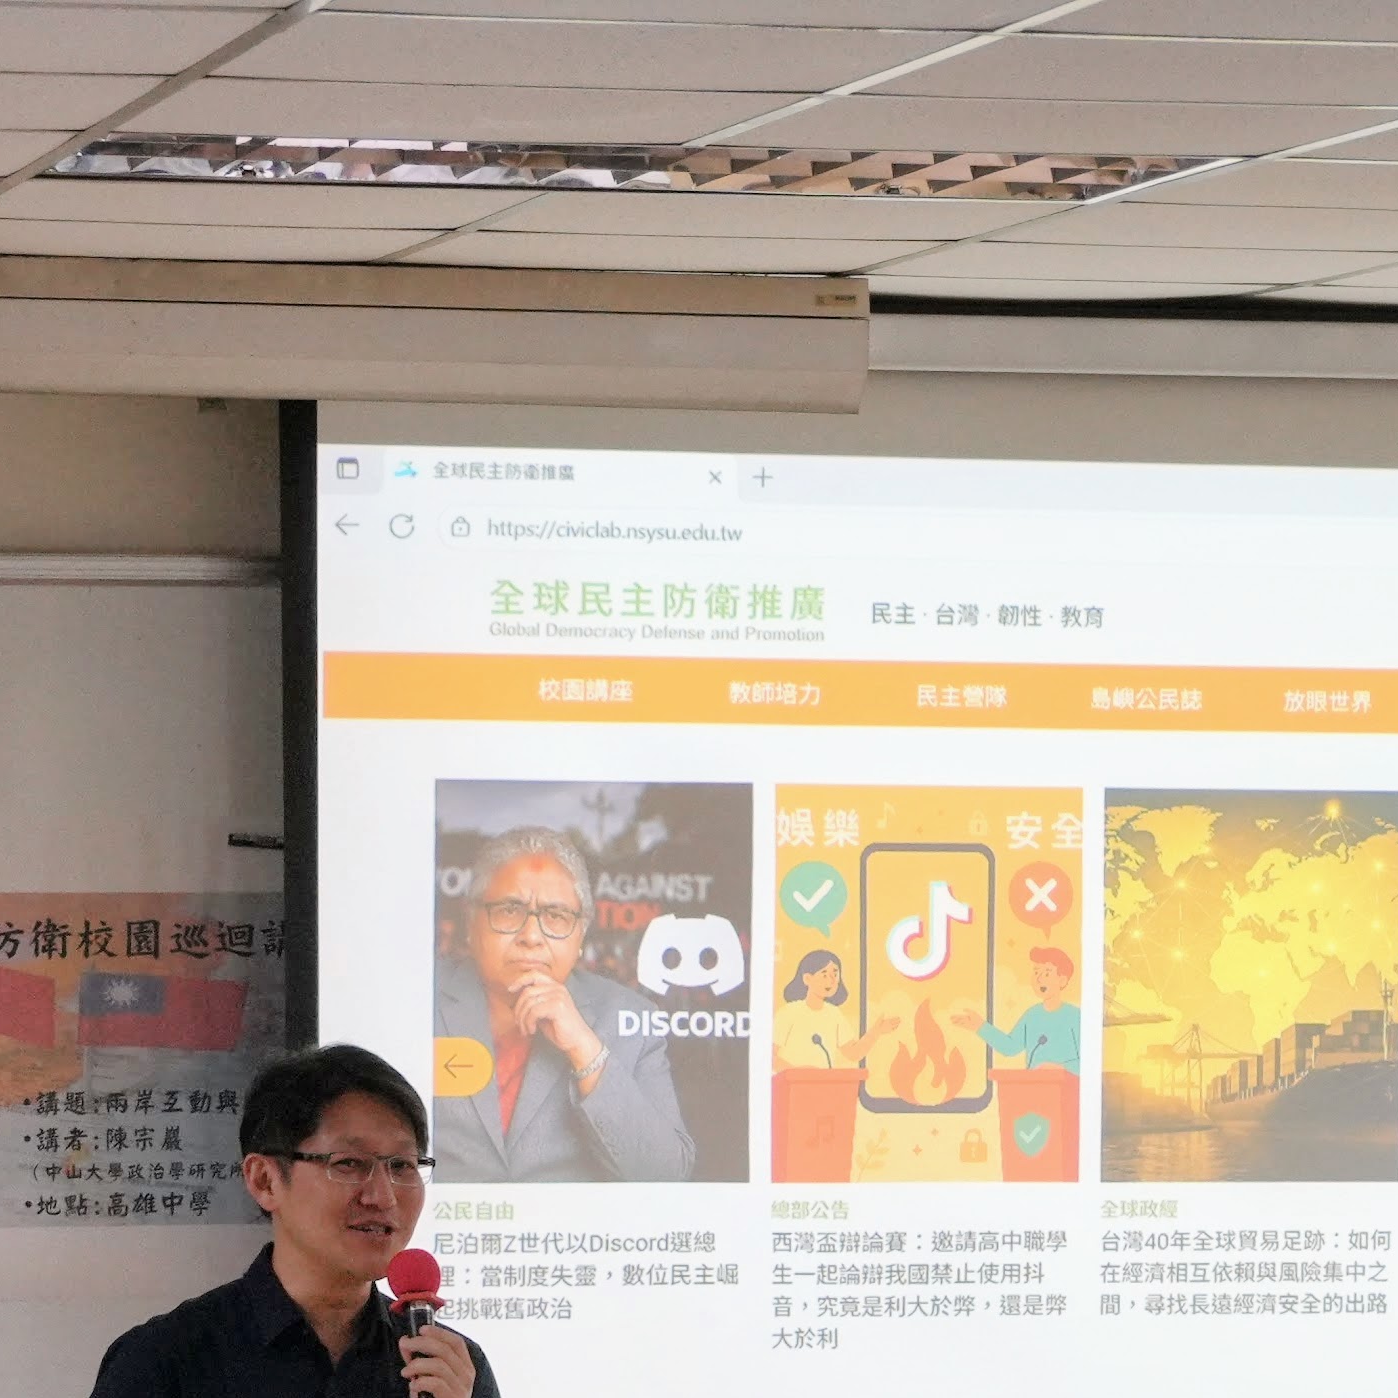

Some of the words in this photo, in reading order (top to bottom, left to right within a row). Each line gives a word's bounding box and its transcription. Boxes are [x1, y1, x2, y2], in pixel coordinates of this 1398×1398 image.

[433, 461, 575, 483] 全球民主防衛推廣
[487, 519, 743, 545] https://civiclab.nsysu.edu.tw
[490, 579, 825, 623] 全球民主防衛推廣
[489, 621, 540, 638] Global
[545, 623, 635, 643] Democracy
[641, 625, 705, 641] Defense
[710, 627, 739, 641] and
[744, 627, 825, 643] Promotion
[538, 677, 634, 703] 校園講座
[728, 681, 821, 707] 教師培力
[917, 684, 1007, 709] 民主營隊
[1284, 689, 1371, 714] 放眼世界
[776, 808, 861, 849] 娛樂
[1005, 811, 1083, 850] 安全
[618, 1009, 751, 1038] DISCORD
[432, 1201, 514, 1221] 公民自由
[1101, 1199, 1179, 1219] 全球政經
[1101, 1230, 1392, 1252] 台灣40年全球貿易足跡：如何
[771, 1262, 1045, 1286] 生一起論辯我國禁止使用抖
[1100, 1261, 1388, 1284] 在經濟相互依賴與風險集中之
[771, 1294, 1068, 1318] 音，究竟是利大於弊，還是弊
[1100, 1293, 1388, 1316] 間，尋找長遠經濟安全的出路
[771, 1327, 839, 1351] 大於利
